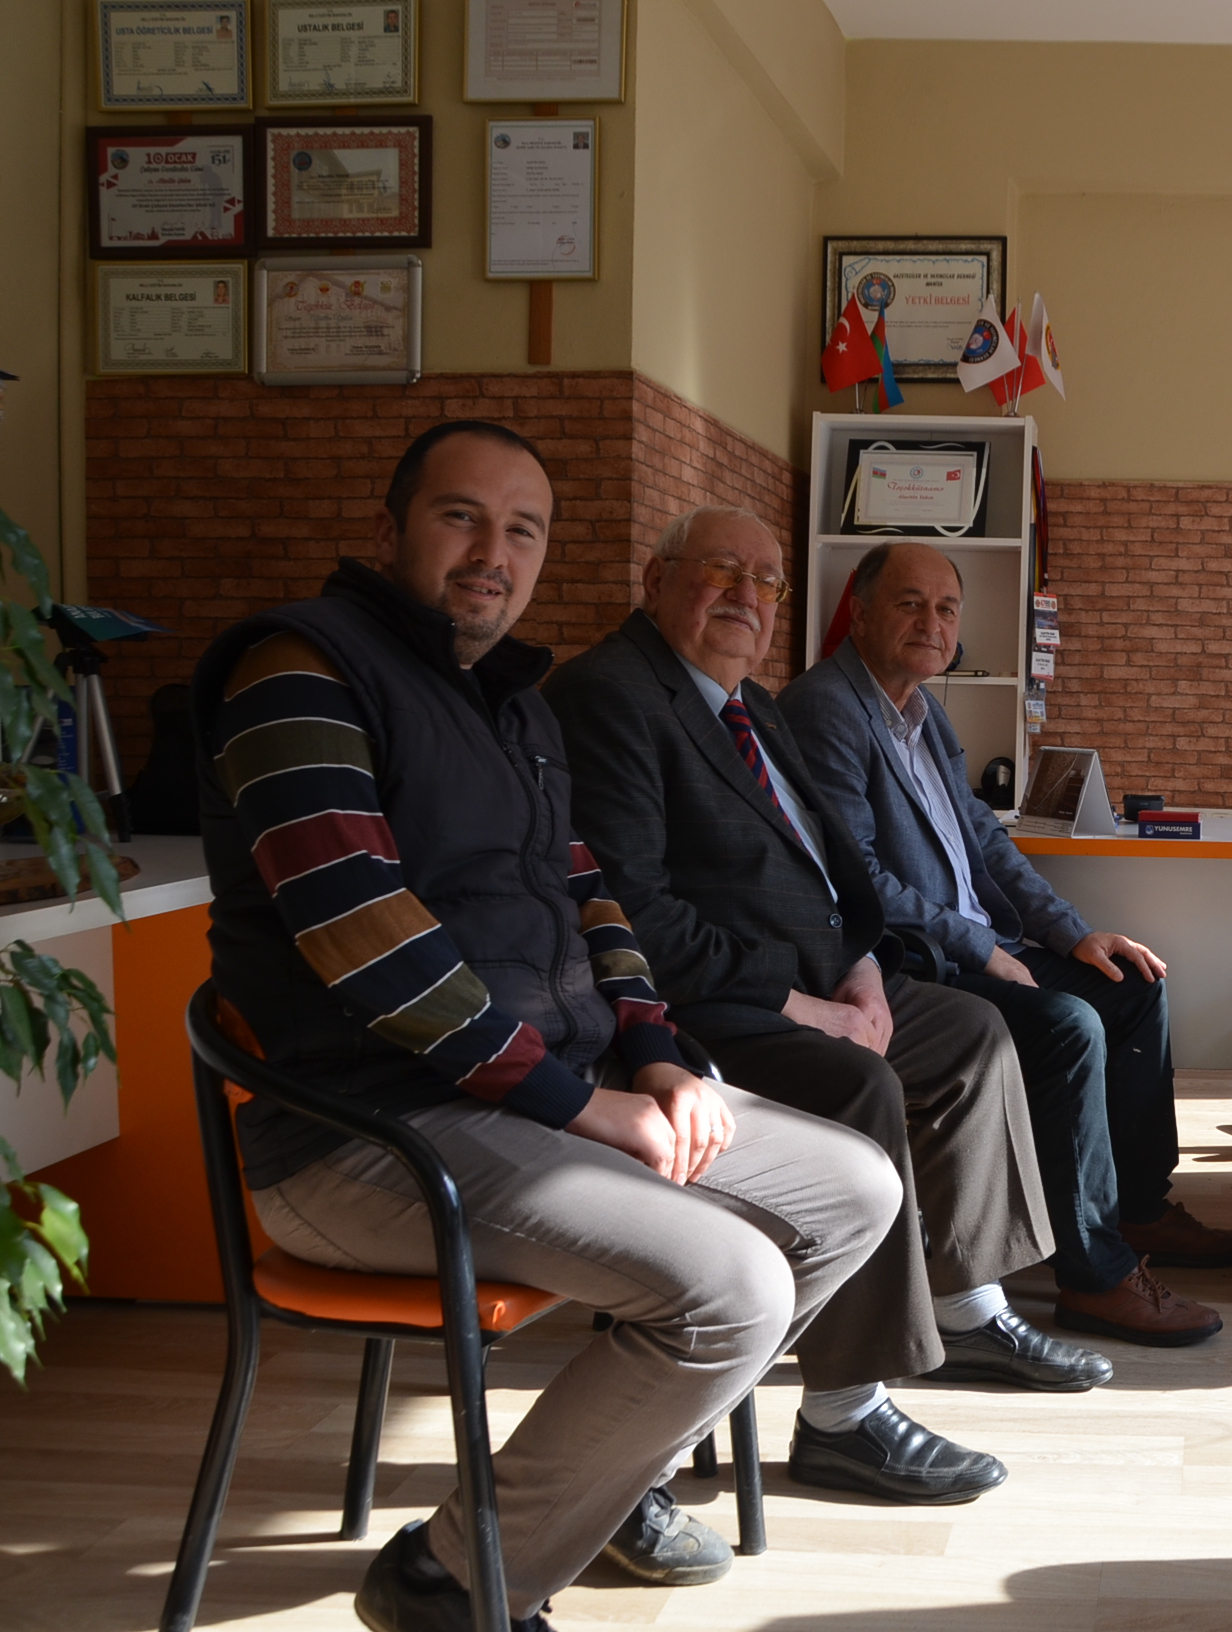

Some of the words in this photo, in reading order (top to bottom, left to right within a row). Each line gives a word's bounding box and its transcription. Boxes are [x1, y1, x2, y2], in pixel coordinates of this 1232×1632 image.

[115, 27, 135, 36] USTA
[136, 25, 181, 36] ÖĞRETİCİLİK
[182, 25, 214, 35] BELGESİ
[297, 23, 330, 33] USTALIK
[331, 21, 364, 32] BELGESİ
[166, 152, 195, 163] OCAK
[125, 293, 163, 302] KALFALIK
[164, 291, 197, 301] BELGESİ
[904, 293, 933, 305] YETKİ
[934, 293, 970, 305] BELGESİ
[1154, 825, 1193, 833] YUNUSEMRE
